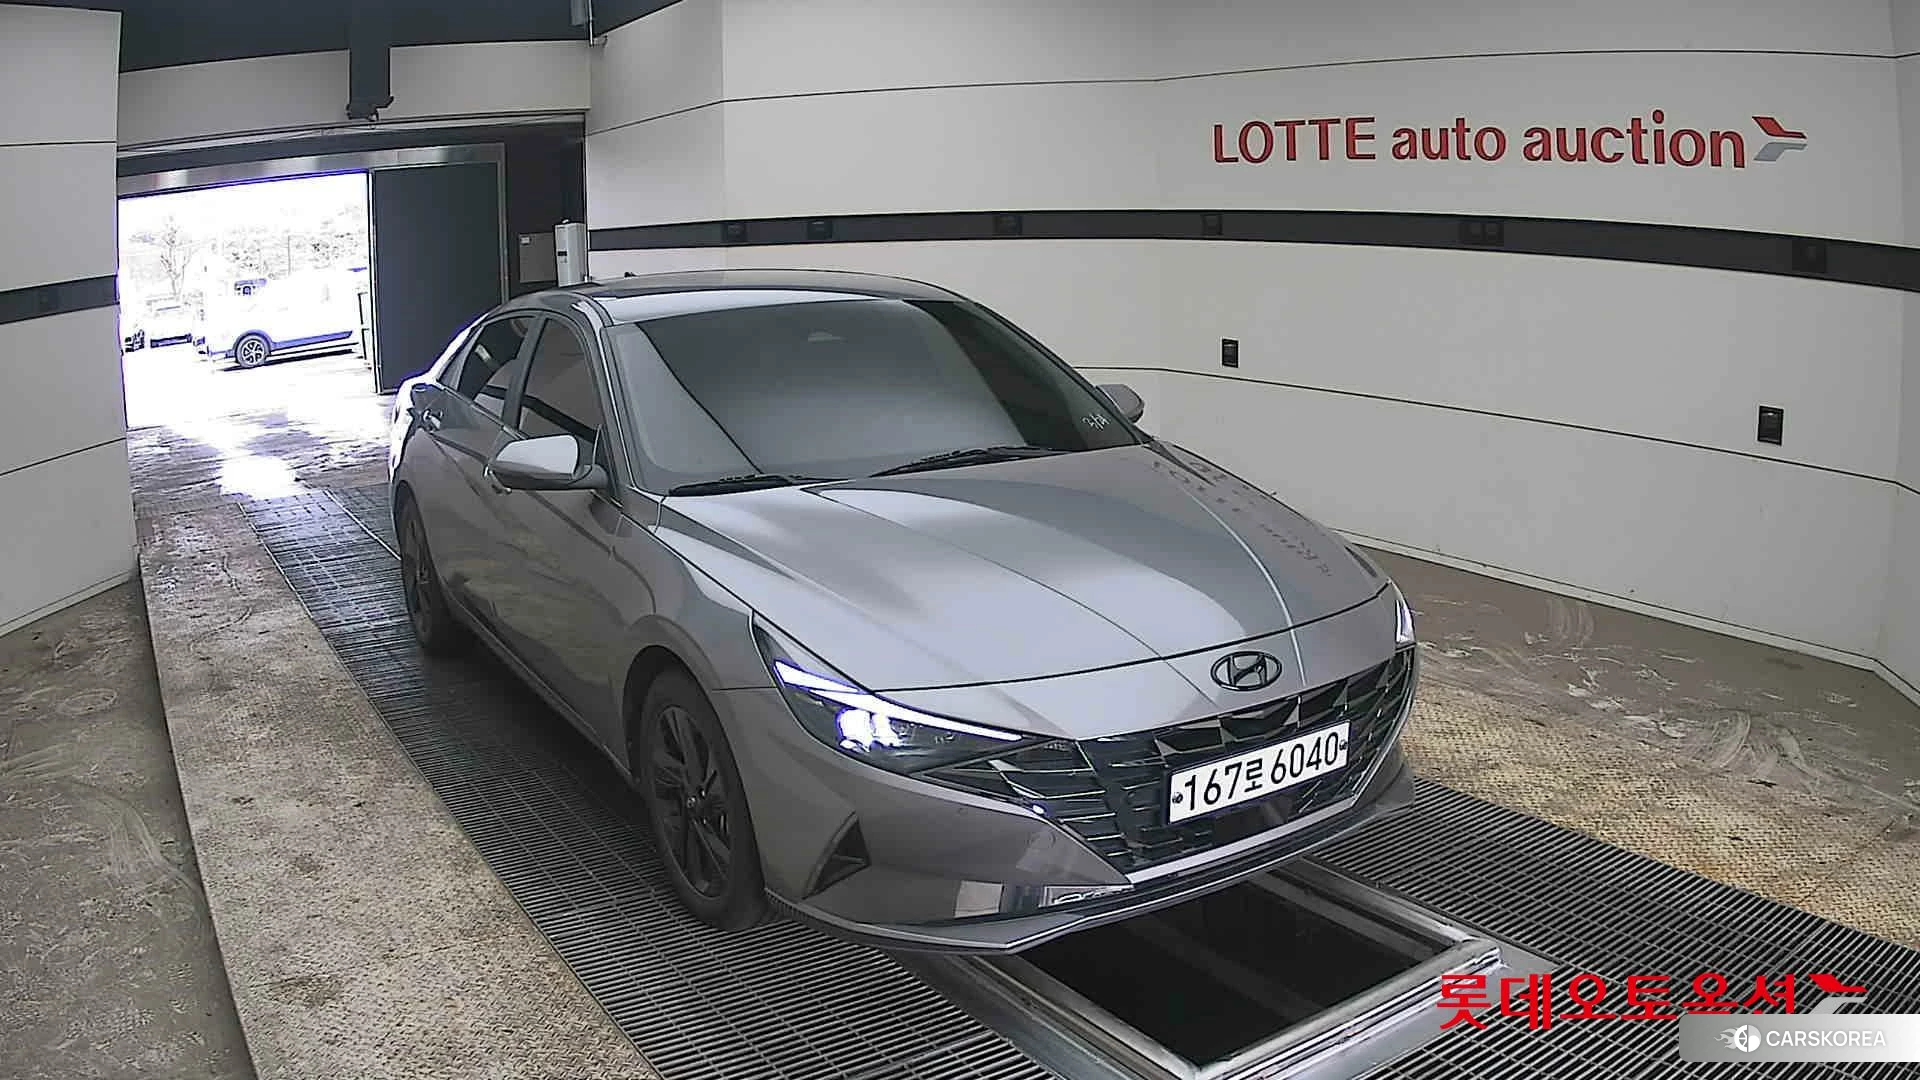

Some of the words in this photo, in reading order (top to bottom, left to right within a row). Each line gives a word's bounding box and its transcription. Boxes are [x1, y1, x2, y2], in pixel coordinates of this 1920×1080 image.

[1213, 116, 1377, 164] LOTTE
[1391, 117, 1507, 162] auto
[1522, 109, 1746, 169] auction
